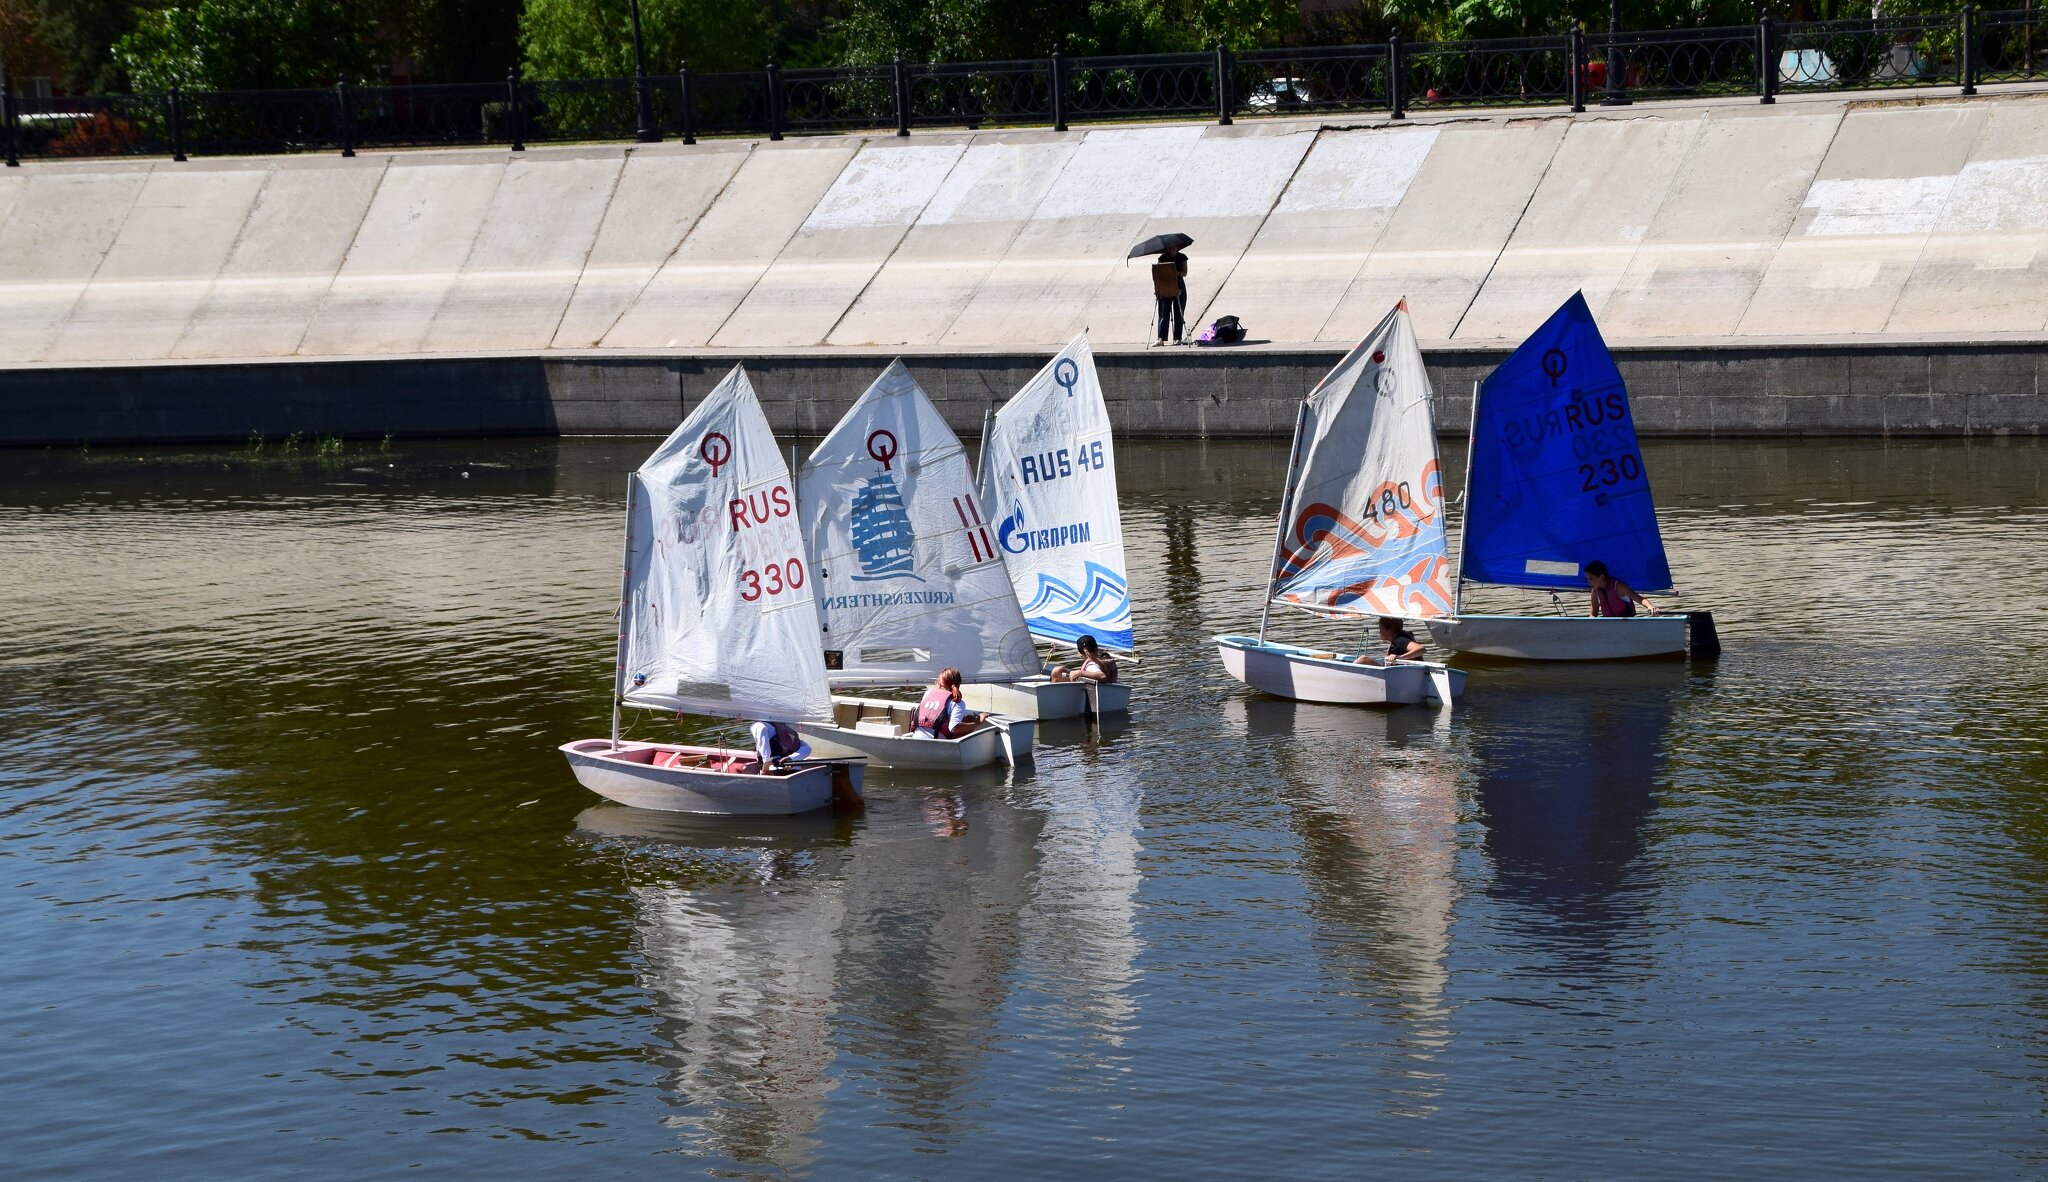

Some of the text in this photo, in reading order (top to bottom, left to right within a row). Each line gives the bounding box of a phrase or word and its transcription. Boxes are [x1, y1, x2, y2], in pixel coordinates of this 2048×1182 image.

[1565, 393, 1625, 432] RUS
[1021, 440, 1105, 485] RUS 46
[1579, 453, 1640, 493] 230
[728, 485, 791, 533] RUS
[1363, 481, 1411, 523] 480
[1030, 521, 1091, 551] ГАЗПРОМ
[741, 557, 805, 602] 330
